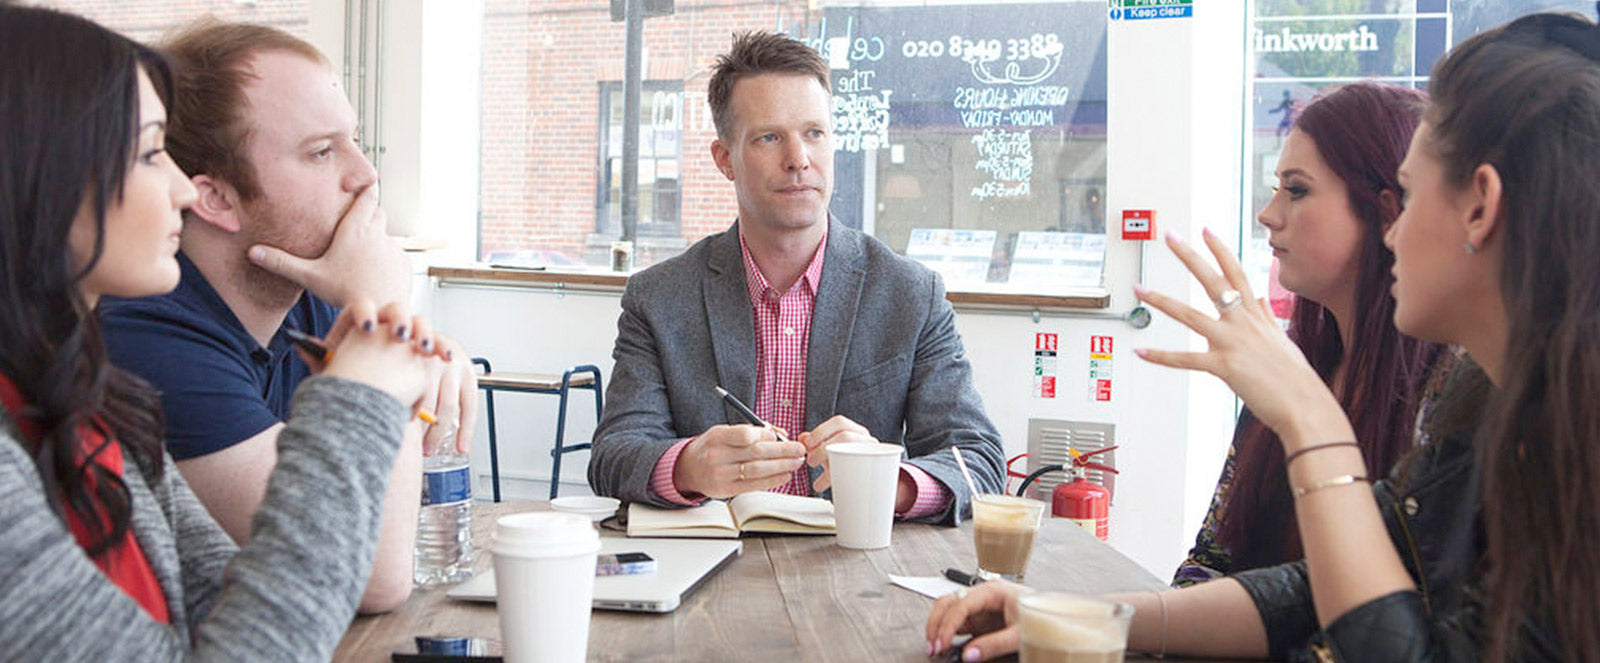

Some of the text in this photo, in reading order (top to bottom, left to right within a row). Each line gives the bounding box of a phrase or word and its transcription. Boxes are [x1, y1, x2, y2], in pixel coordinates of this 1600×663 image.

[1130, 6, 1185, 19] Keep clear
[902, 40, 944, 57] 020
[1006, 33, 1060, 60] 3388
[1252, 25, 1379, 52] inkworth
